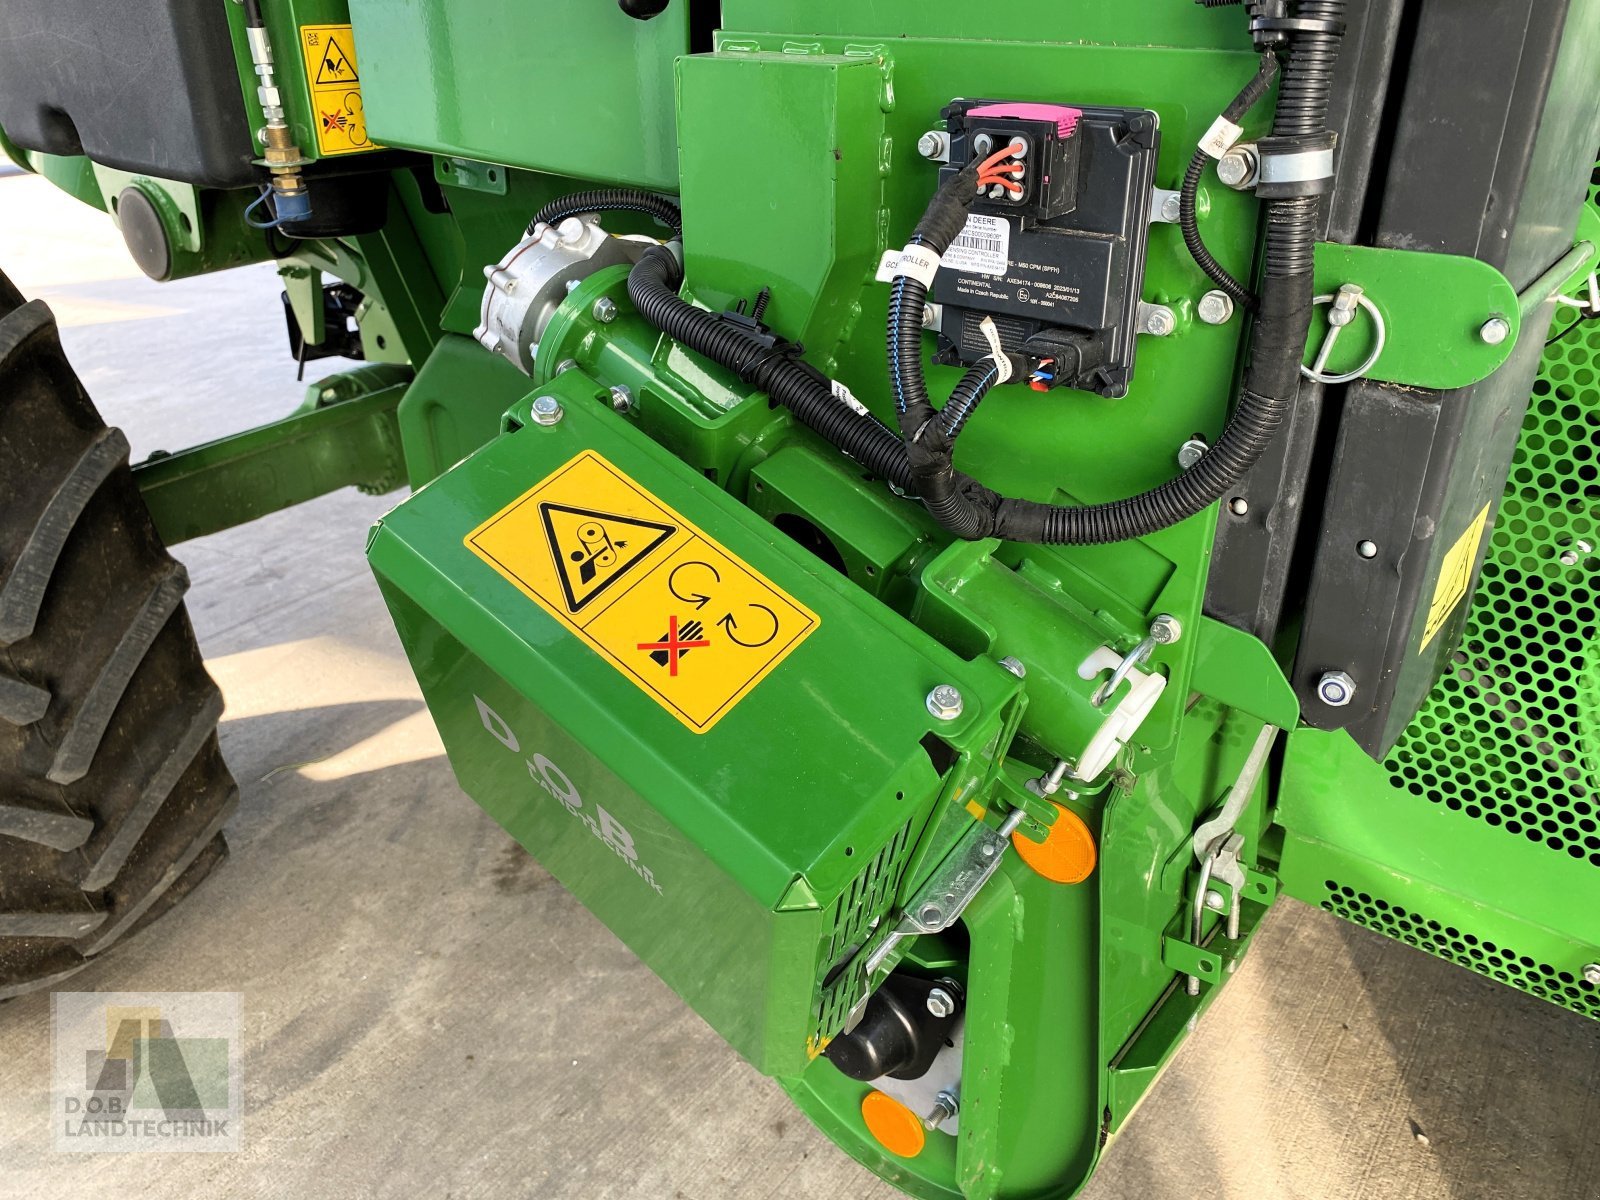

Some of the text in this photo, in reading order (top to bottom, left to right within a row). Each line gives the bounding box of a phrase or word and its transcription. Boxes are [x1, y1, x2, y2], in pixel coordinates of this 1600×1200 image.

[973, 216, 996, 226] DEERE
[1029, 263, 1041, 271] CPM
[1042, 265, 1060, 274] (SPFH)
[958, 278, 992, 289] CONTINENTAL
[957, 286, 969, 294] Made
[975, 289, 989, 297] Czech
[990, 291, 1009, 300] Republic
[527, 767, 664, 897] LANDTECHNIK
